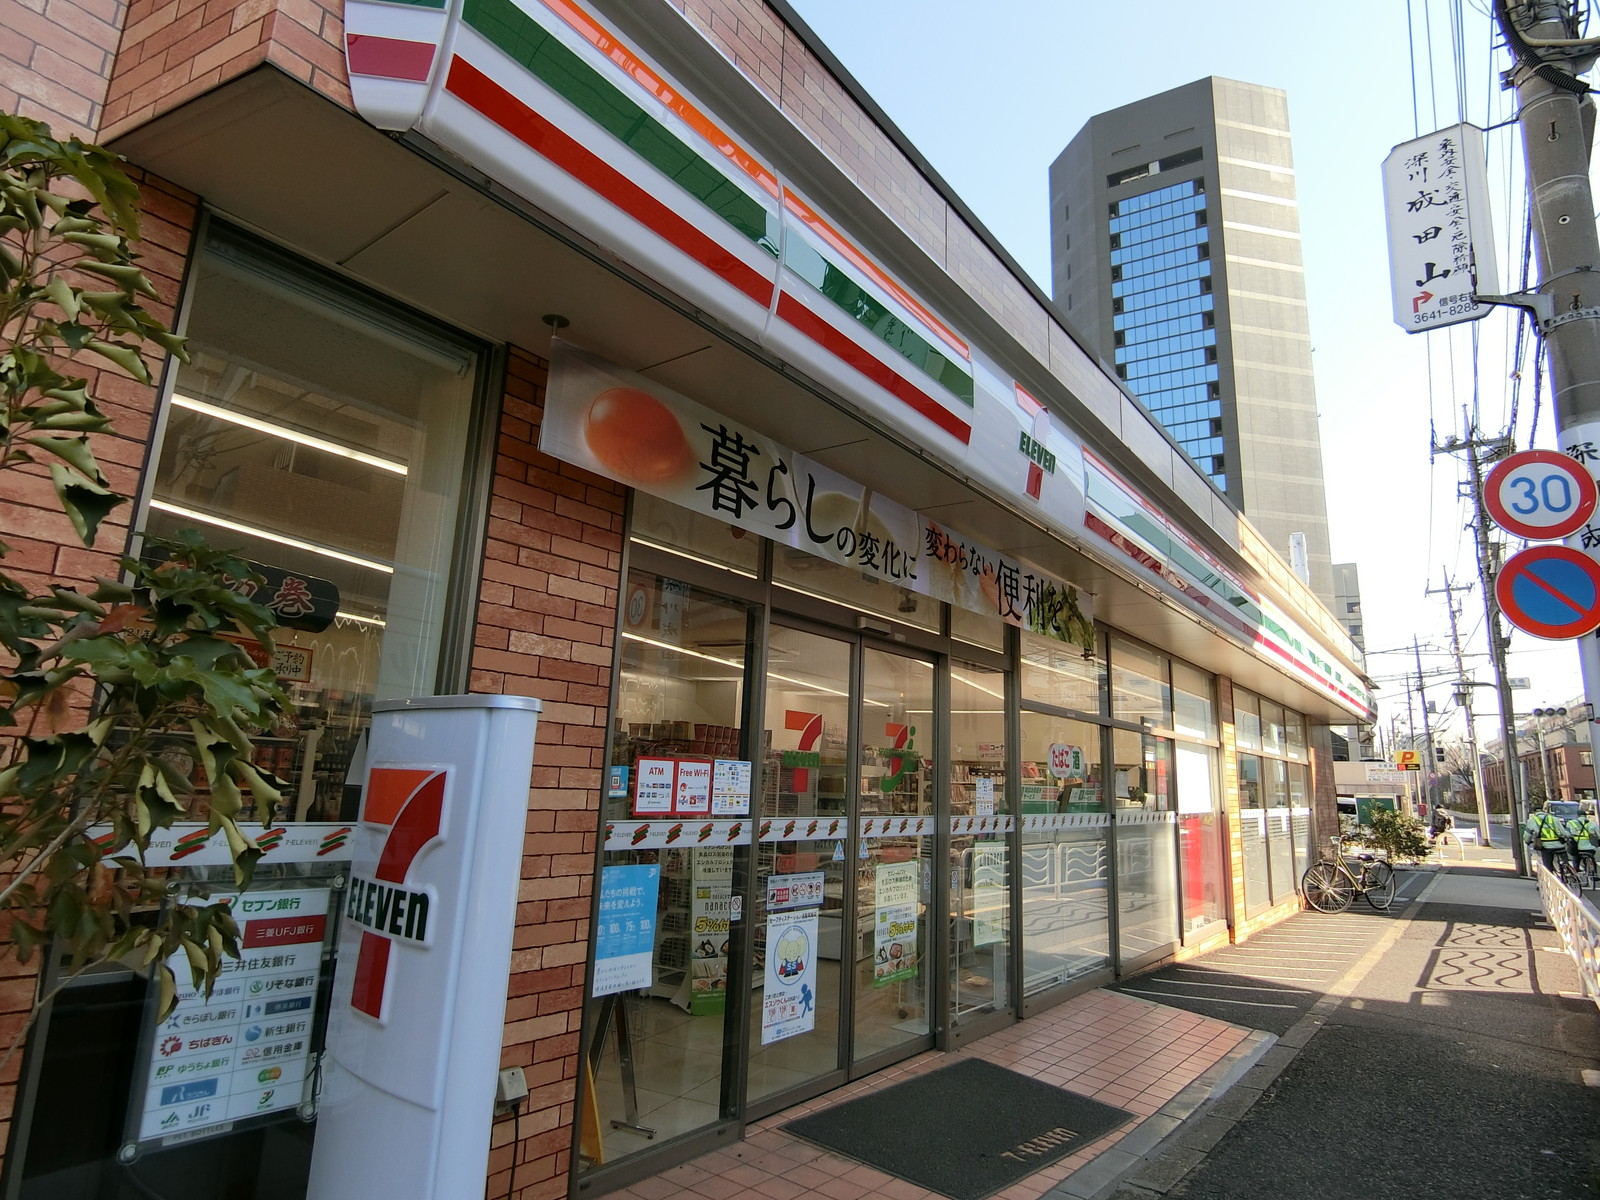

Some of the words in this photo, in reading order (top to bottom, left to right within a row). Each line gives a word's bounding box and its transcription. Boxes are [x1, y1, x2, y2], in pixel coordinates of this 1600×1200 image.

[1405, 151, 1451, 288] 深川成田山
[695, 422, 918, 581] 暮らしの変化に
[1510, 474, 1572, 515] 30
[924, 526, 1063, 634] 変わらない便利を
[275, 650, 305, 665] ご予約
[275, 662, 302, 677] 承り中
[1051, 748, 1070, 769] たばこ
[648, 766, 665, 776] ATM
[679, 768, 693, 777] Free
[693, 768, 710, 778] Wi-Fi
[242, 897, 301, 913] セブン銀行
[256, 924, 315, 939] 三菱UFJ銀行
[222, 954, 297, 973] 三井住友銀行
[786, 961, 797, 971] SS
[265, 975, 315, 991] りそな銀行
[183, 1008, 237, 1025] きらぼし銀行
[265, 1020, 307, 1037] 新生銀行
[188, 1034, 233, 1050] ちばぎん
[263, 1041, 304, 1057] 信用金庫
[177, 1056, 231, 1073] ゆうちょ銀行
[1000, 1126, 1080, 1162] 7-ELEVEN
